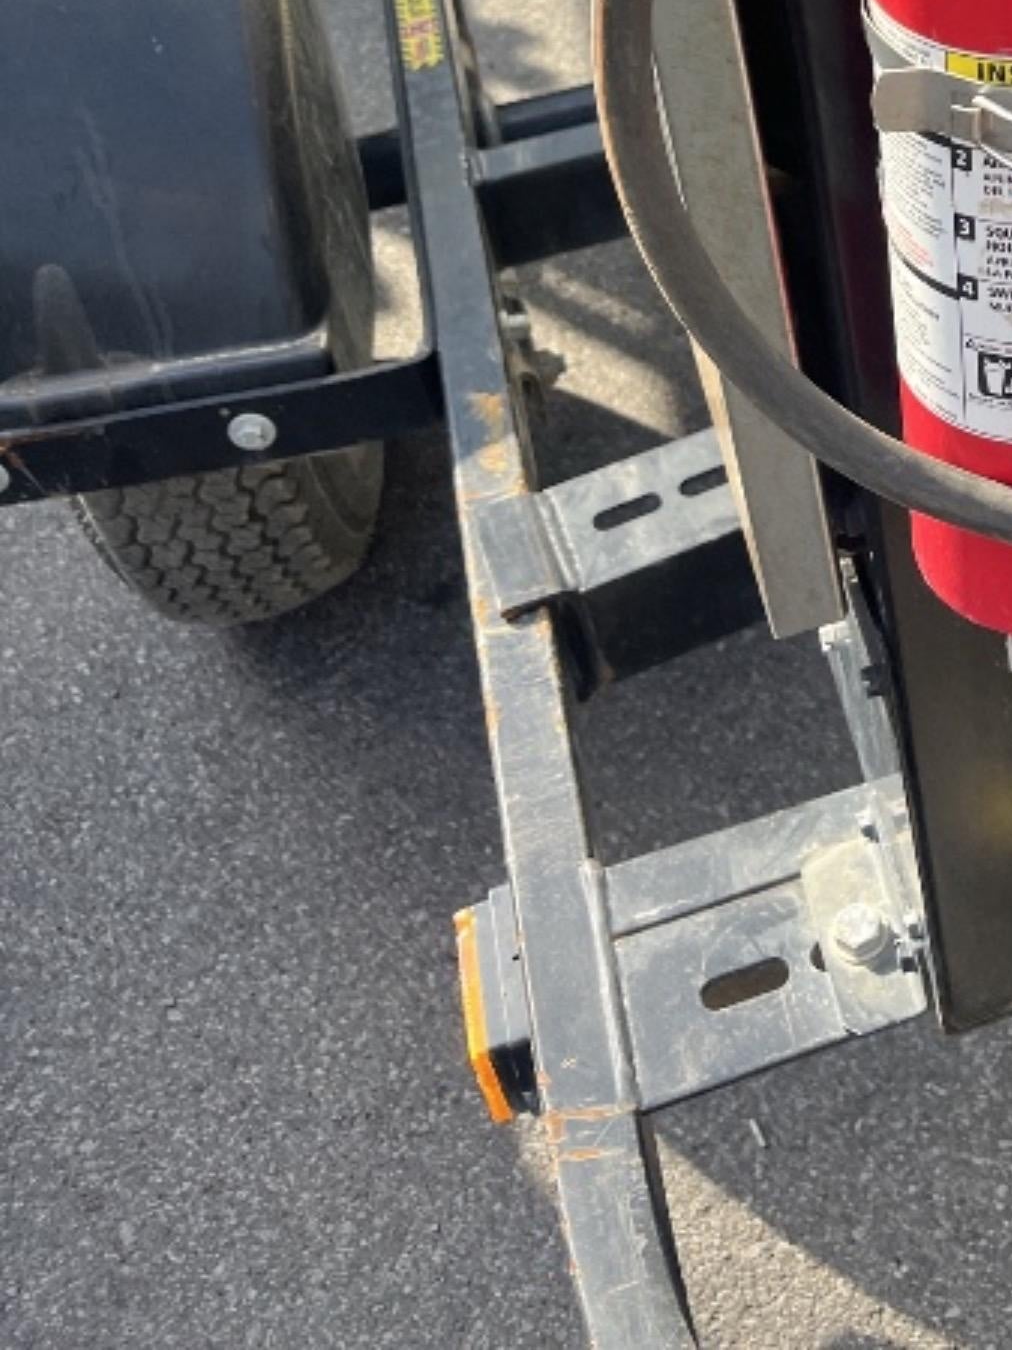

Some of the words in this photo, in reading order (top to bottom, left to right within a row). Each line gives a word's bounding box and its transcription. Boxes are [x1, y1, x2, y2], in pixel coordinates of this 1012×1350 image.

[956, 150, 967, 166] 2
[960, 217, 970, 233] 3
[962, 282, 974, 296] 4
